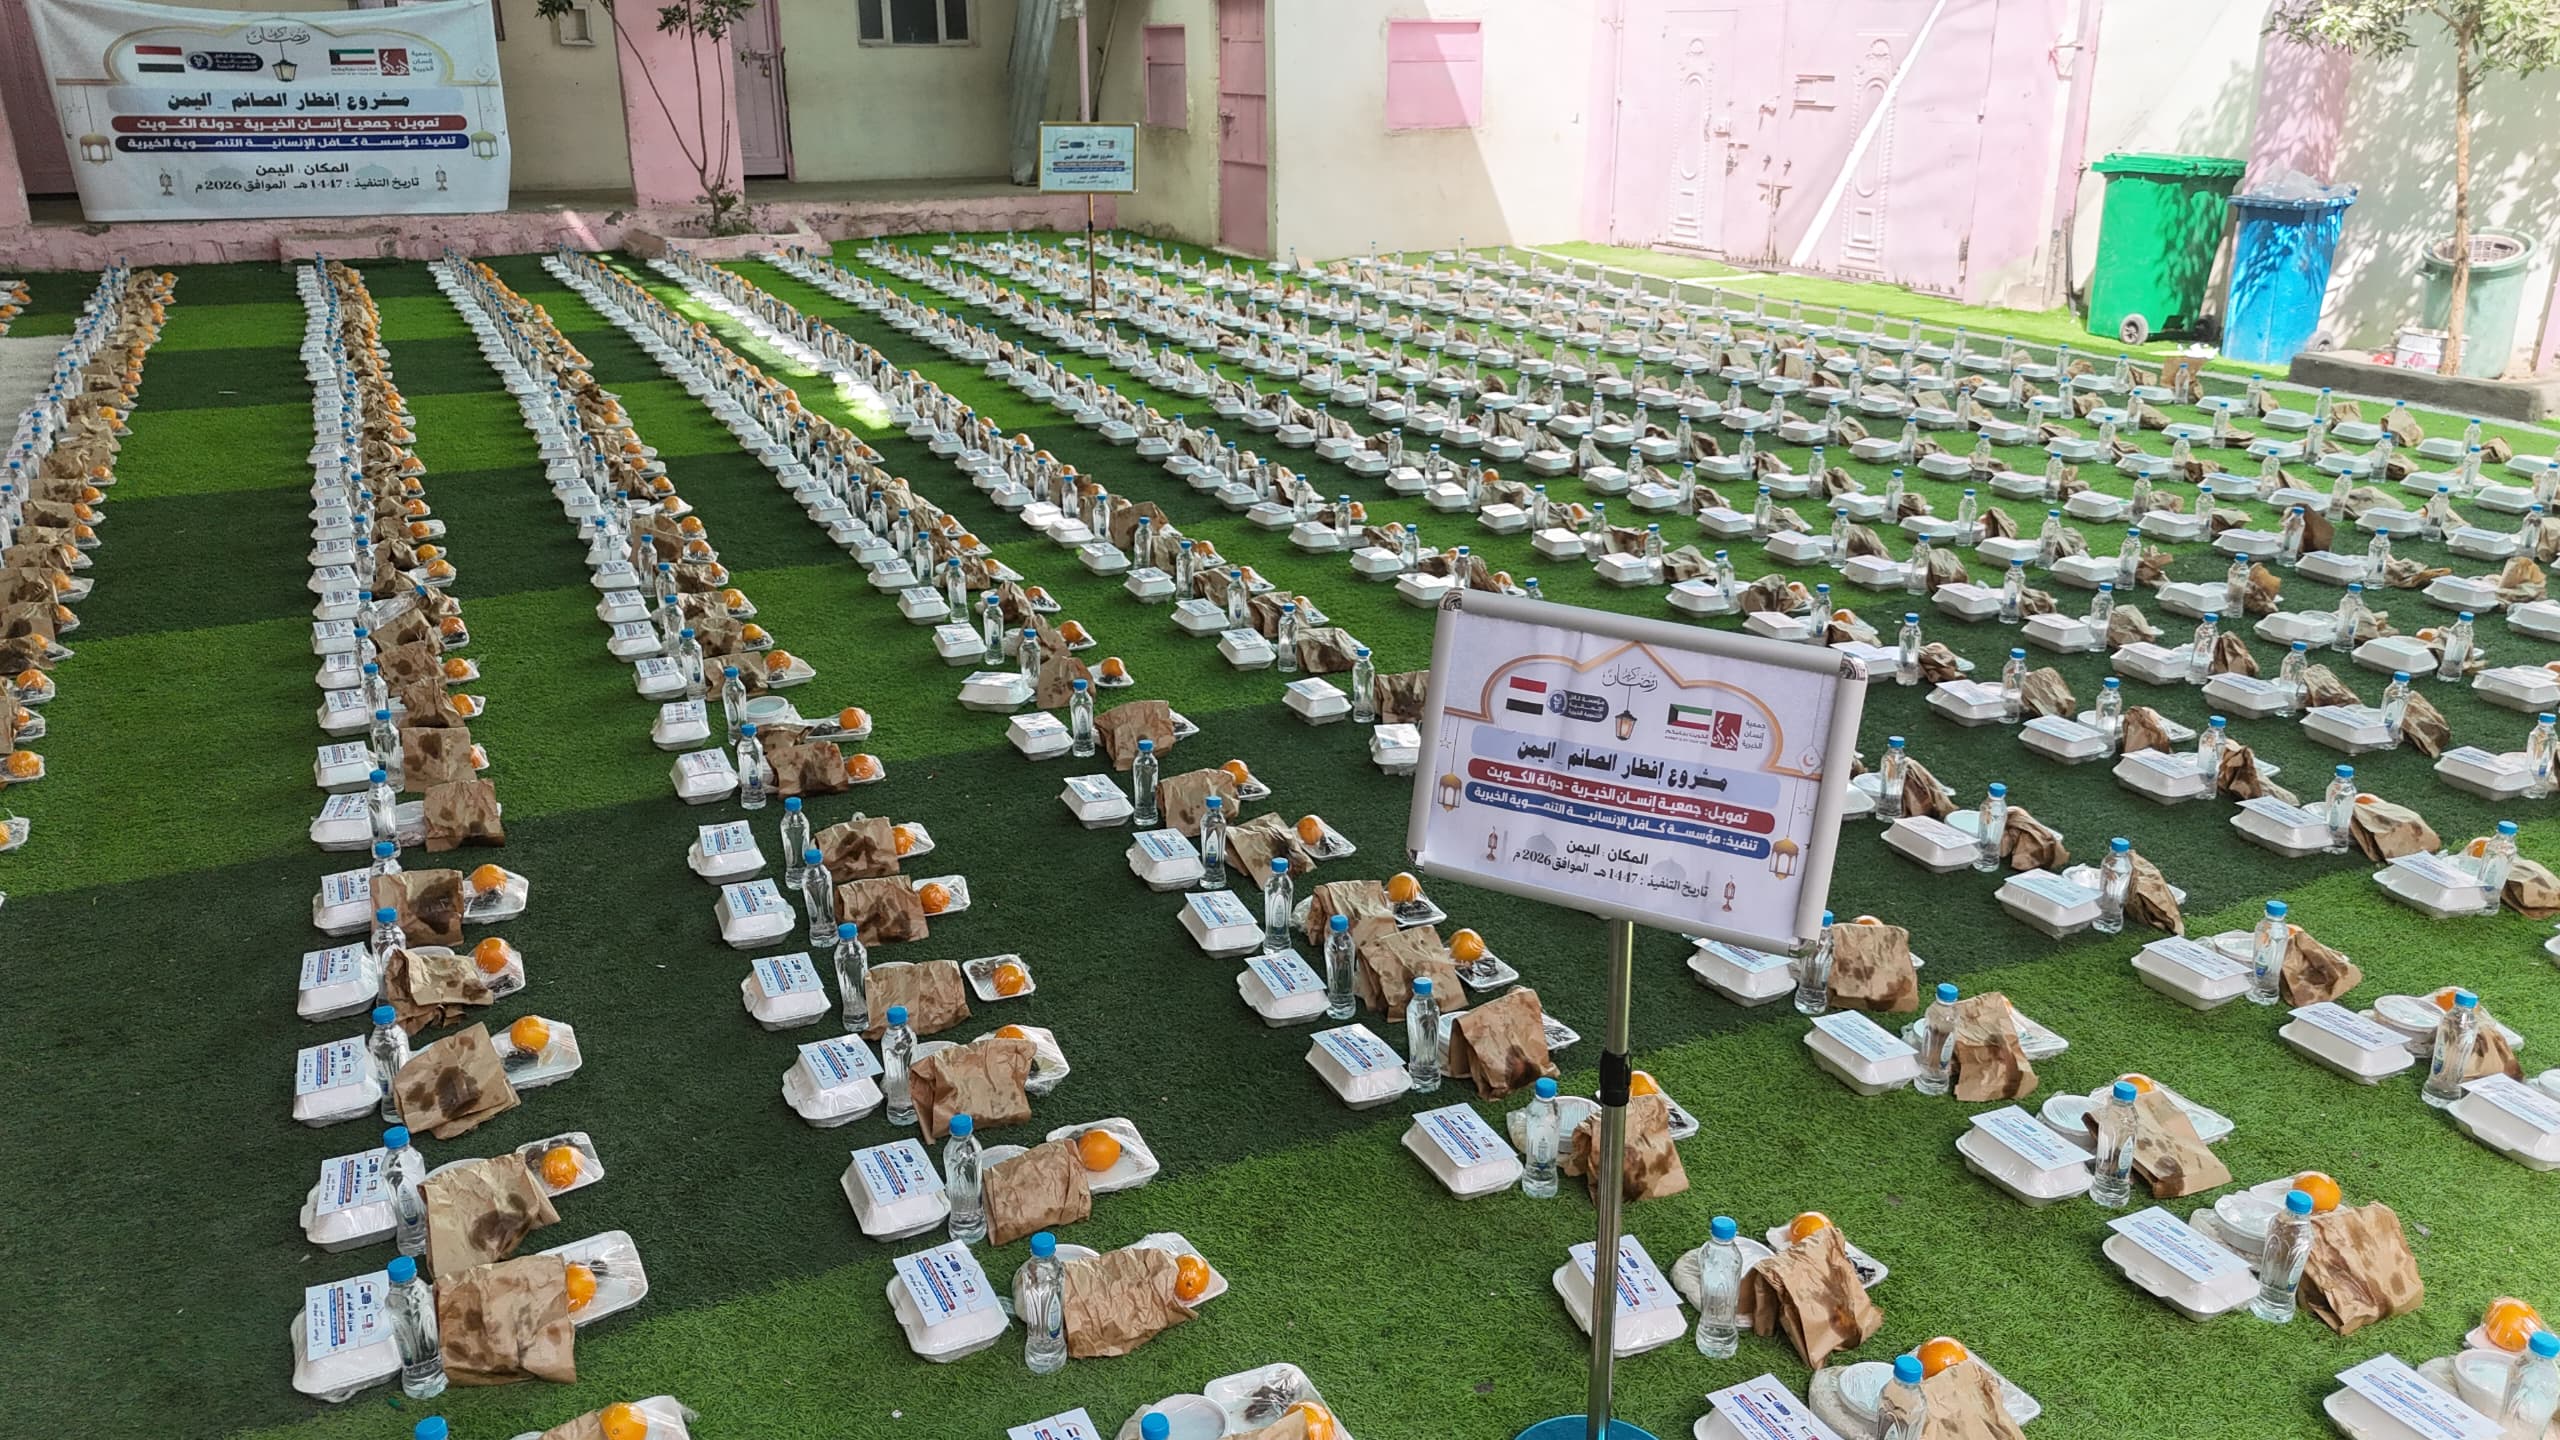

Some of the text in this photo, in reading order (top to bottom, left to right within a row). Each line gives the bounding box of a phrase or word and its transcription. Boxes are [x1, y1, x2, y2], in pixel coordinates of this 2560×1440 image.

[168, 92, 212, 110] اليمن
[296, 91, 340, 110] إفطار
[347, 91, 410, 110] مشروع
[136, 117, 197, 131] الكويت
[200, 118, 234, 131] دولة
[243, 118, 295, 132] الخيرية
[297, 118, 341, 132] إنسان
[343, 119, 392, 131] جمعية
[394, 117, 440, 130] تمويل:
[127, 135, 457, 150] تنفيذ: مؤسسة كافل الإنسانية التنموية الخيرية
[255, 163, 294, 177] اليمن
[304, 162, 349, 176] المكان
[243, 178, 287, 192] الموافق
[354, 176, 390, 189] التنفيذ
[391, 176, 420, 190] تاريخ
[1745, 719, 1767, 730] جمعية
[1743, 729, 1765, 742] إنسان
[1517, 741, 1557, 763] اليمن
[1486, 766, 1536, 784] الكويت
[1621, 757, 1664, 785] إفطار
[1536, 775, 1564, 792] دولة
[1667, 768, 1728, 792] مشروع
[1570, 781, 1616, 801] الخيرية
[1616, 790, 1657, 813] إنسان
[1657, 797, 1702, 818] جمعية
[1474, 786, 1760, 852] تنفيذ: مؤسسة كافل الإنسانية التنموية الخيرية
[1704, 807, 1750, 825] تمويل:
[1566, 838, 1601, 859] اليمن
[1607, 847, 1649, 866] المكان
[1551, 856, 1589, 875] الموافق
[1647, 873, 1681, 892] التنفيذ
[1681, 881, 1710, 898] تاريخ
